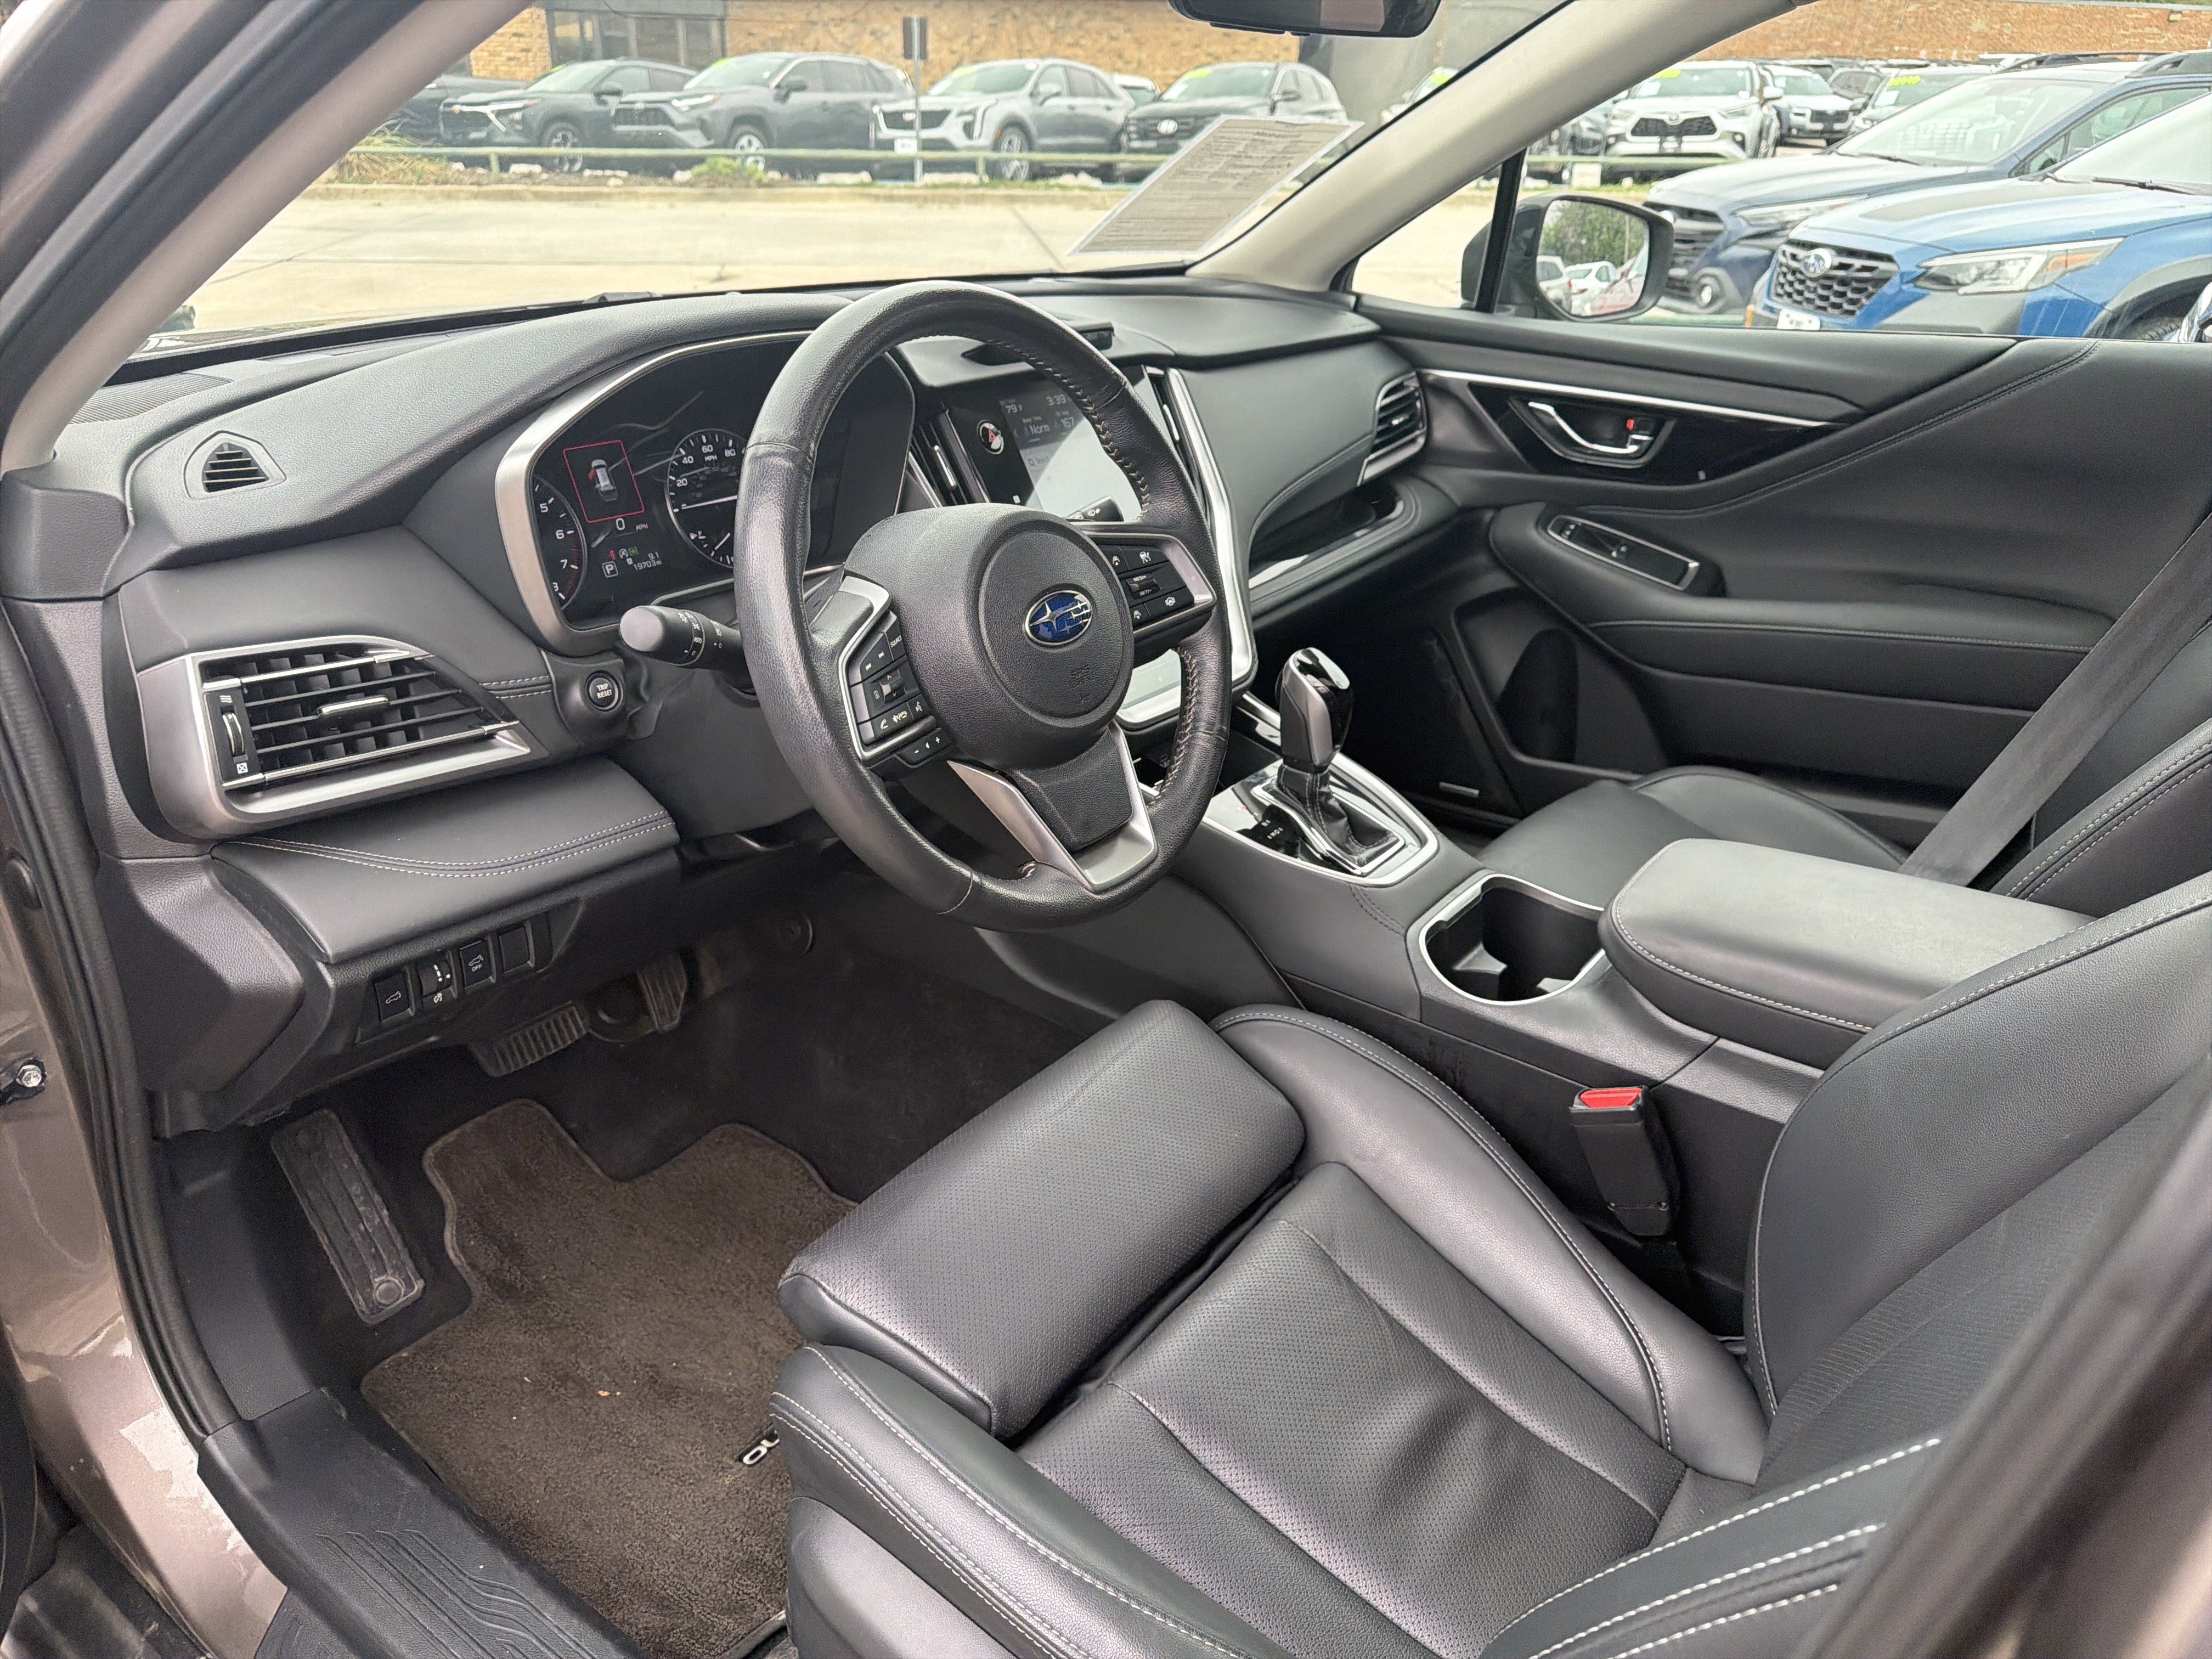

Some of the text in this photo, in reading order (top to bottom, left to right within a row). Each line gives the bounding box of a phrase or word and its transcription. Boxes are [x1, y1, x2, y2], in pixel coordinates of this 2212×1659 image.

[702, 445, 713, 453] 60
[724, 448, 736, 458] 80
[682, 455, 694, 465] 40
[676, 478, 688, 487] 20
[539, 504, 549, 514] 5
[616, 518, 649, 532] 0 MPH
[555, 529, 565, 539] 6
[560, 559, 569, 569] 7
[890, 635, 902, 648] SOURCE
[596, 683, 608, 691] TRIP
[596, 689, 612, 699] RESET
[472, 963, 482, 972] OFF
